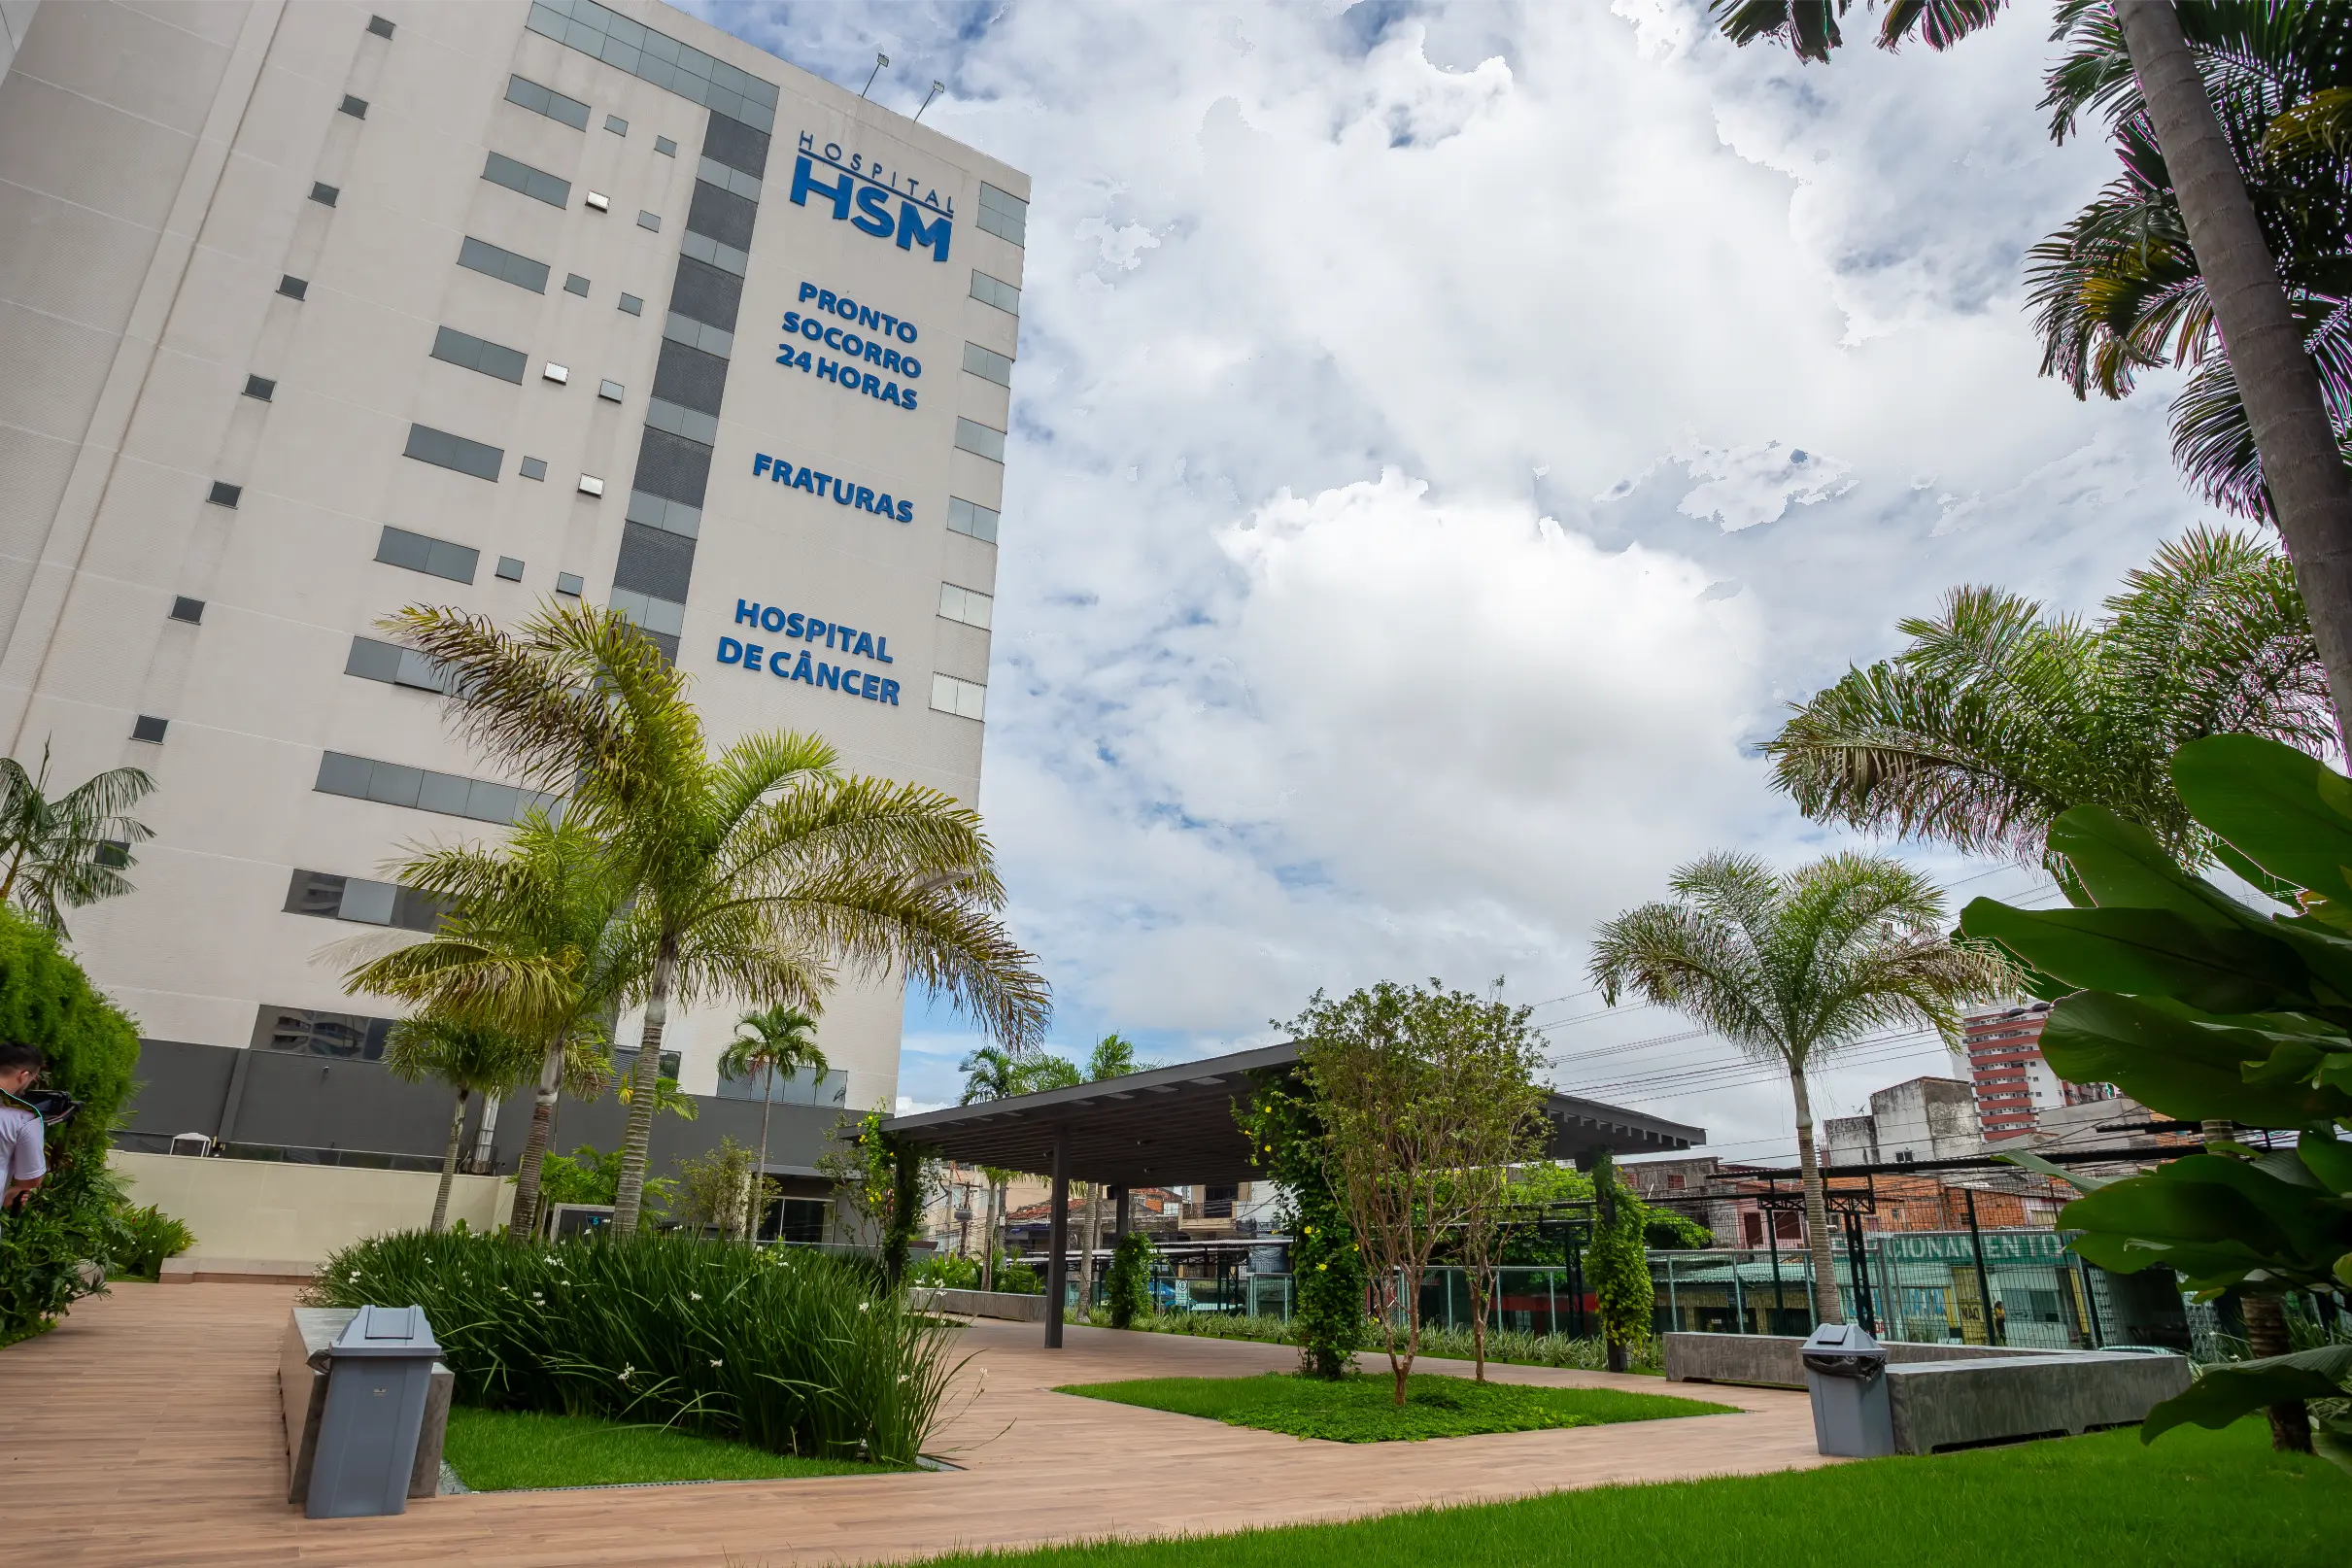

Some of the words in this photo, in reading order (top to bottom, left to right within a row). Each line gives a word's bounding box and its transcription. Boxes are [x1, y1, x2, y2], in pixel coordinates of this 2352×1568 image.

[799, 130, 954, 214] HOSPITAL
[790, 154, 953, 262] HSM
[781, 311, 922, 379] SOCORRO
[799, 281, 918, 344] PRONTO
[776, 343, 812, 373] 24
[816, 358, 918, 411] HORAS
[753, 453, 914, 523] FRATURAS
[735, 598, 894, 664] HOSPITAL
[717, 636, 764, 671] DE
[769, 649, 901, 706] CÂNCER
